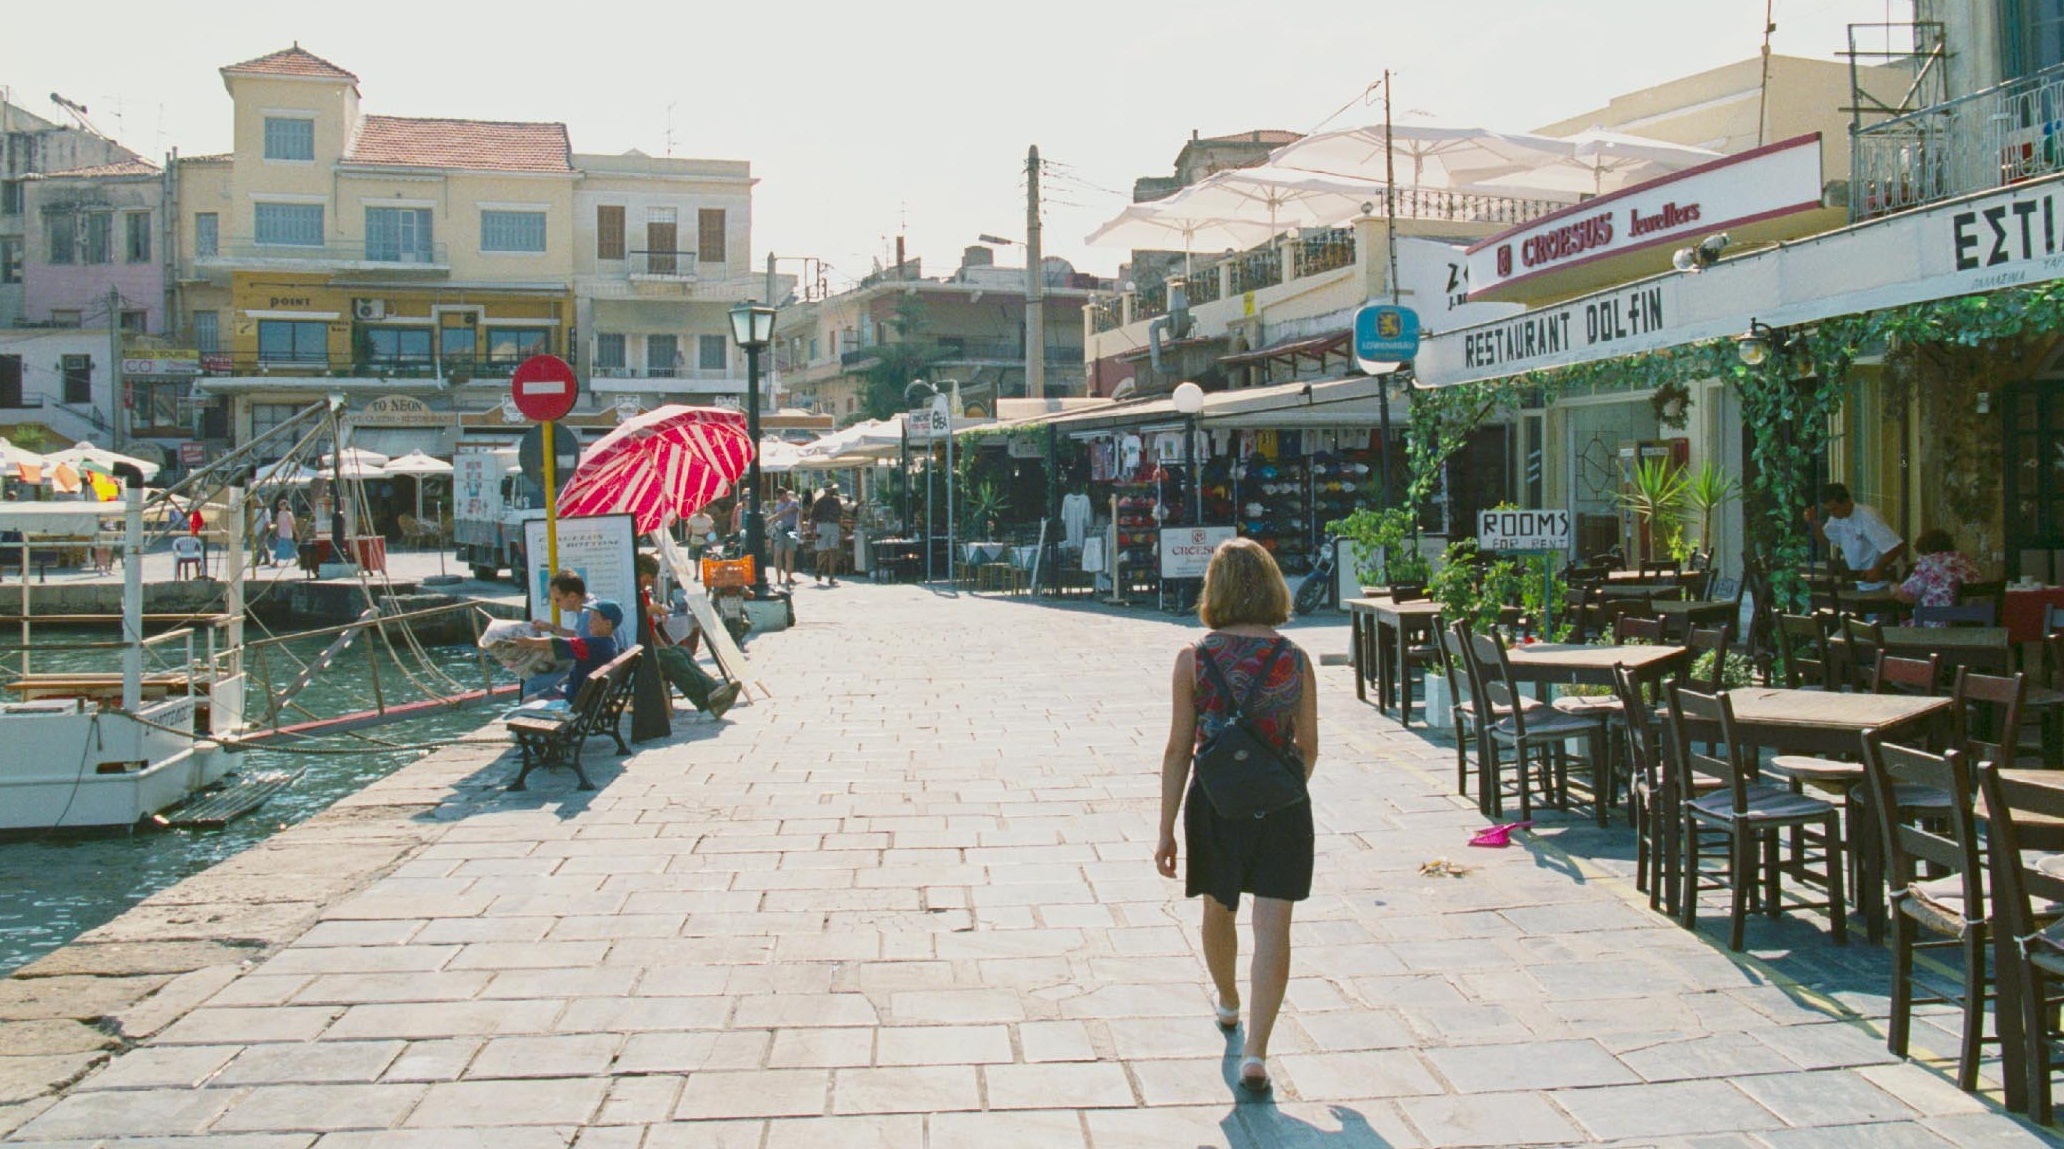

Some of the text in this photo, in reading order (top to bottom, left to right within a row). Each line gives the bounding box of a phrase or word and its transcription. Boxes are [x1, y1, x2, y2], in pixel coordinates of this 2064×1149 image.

[1628, 201, 1701, 237] Jewellers
[1953, 195, 2064, 271] ΕΣΤΙ
[1465, 287, 1663, 368] RESTAURANT DOLFIN
[1483, 513, 1569, 536] ROOMS
[1493, 539, 1566, 550] FOR RENT
